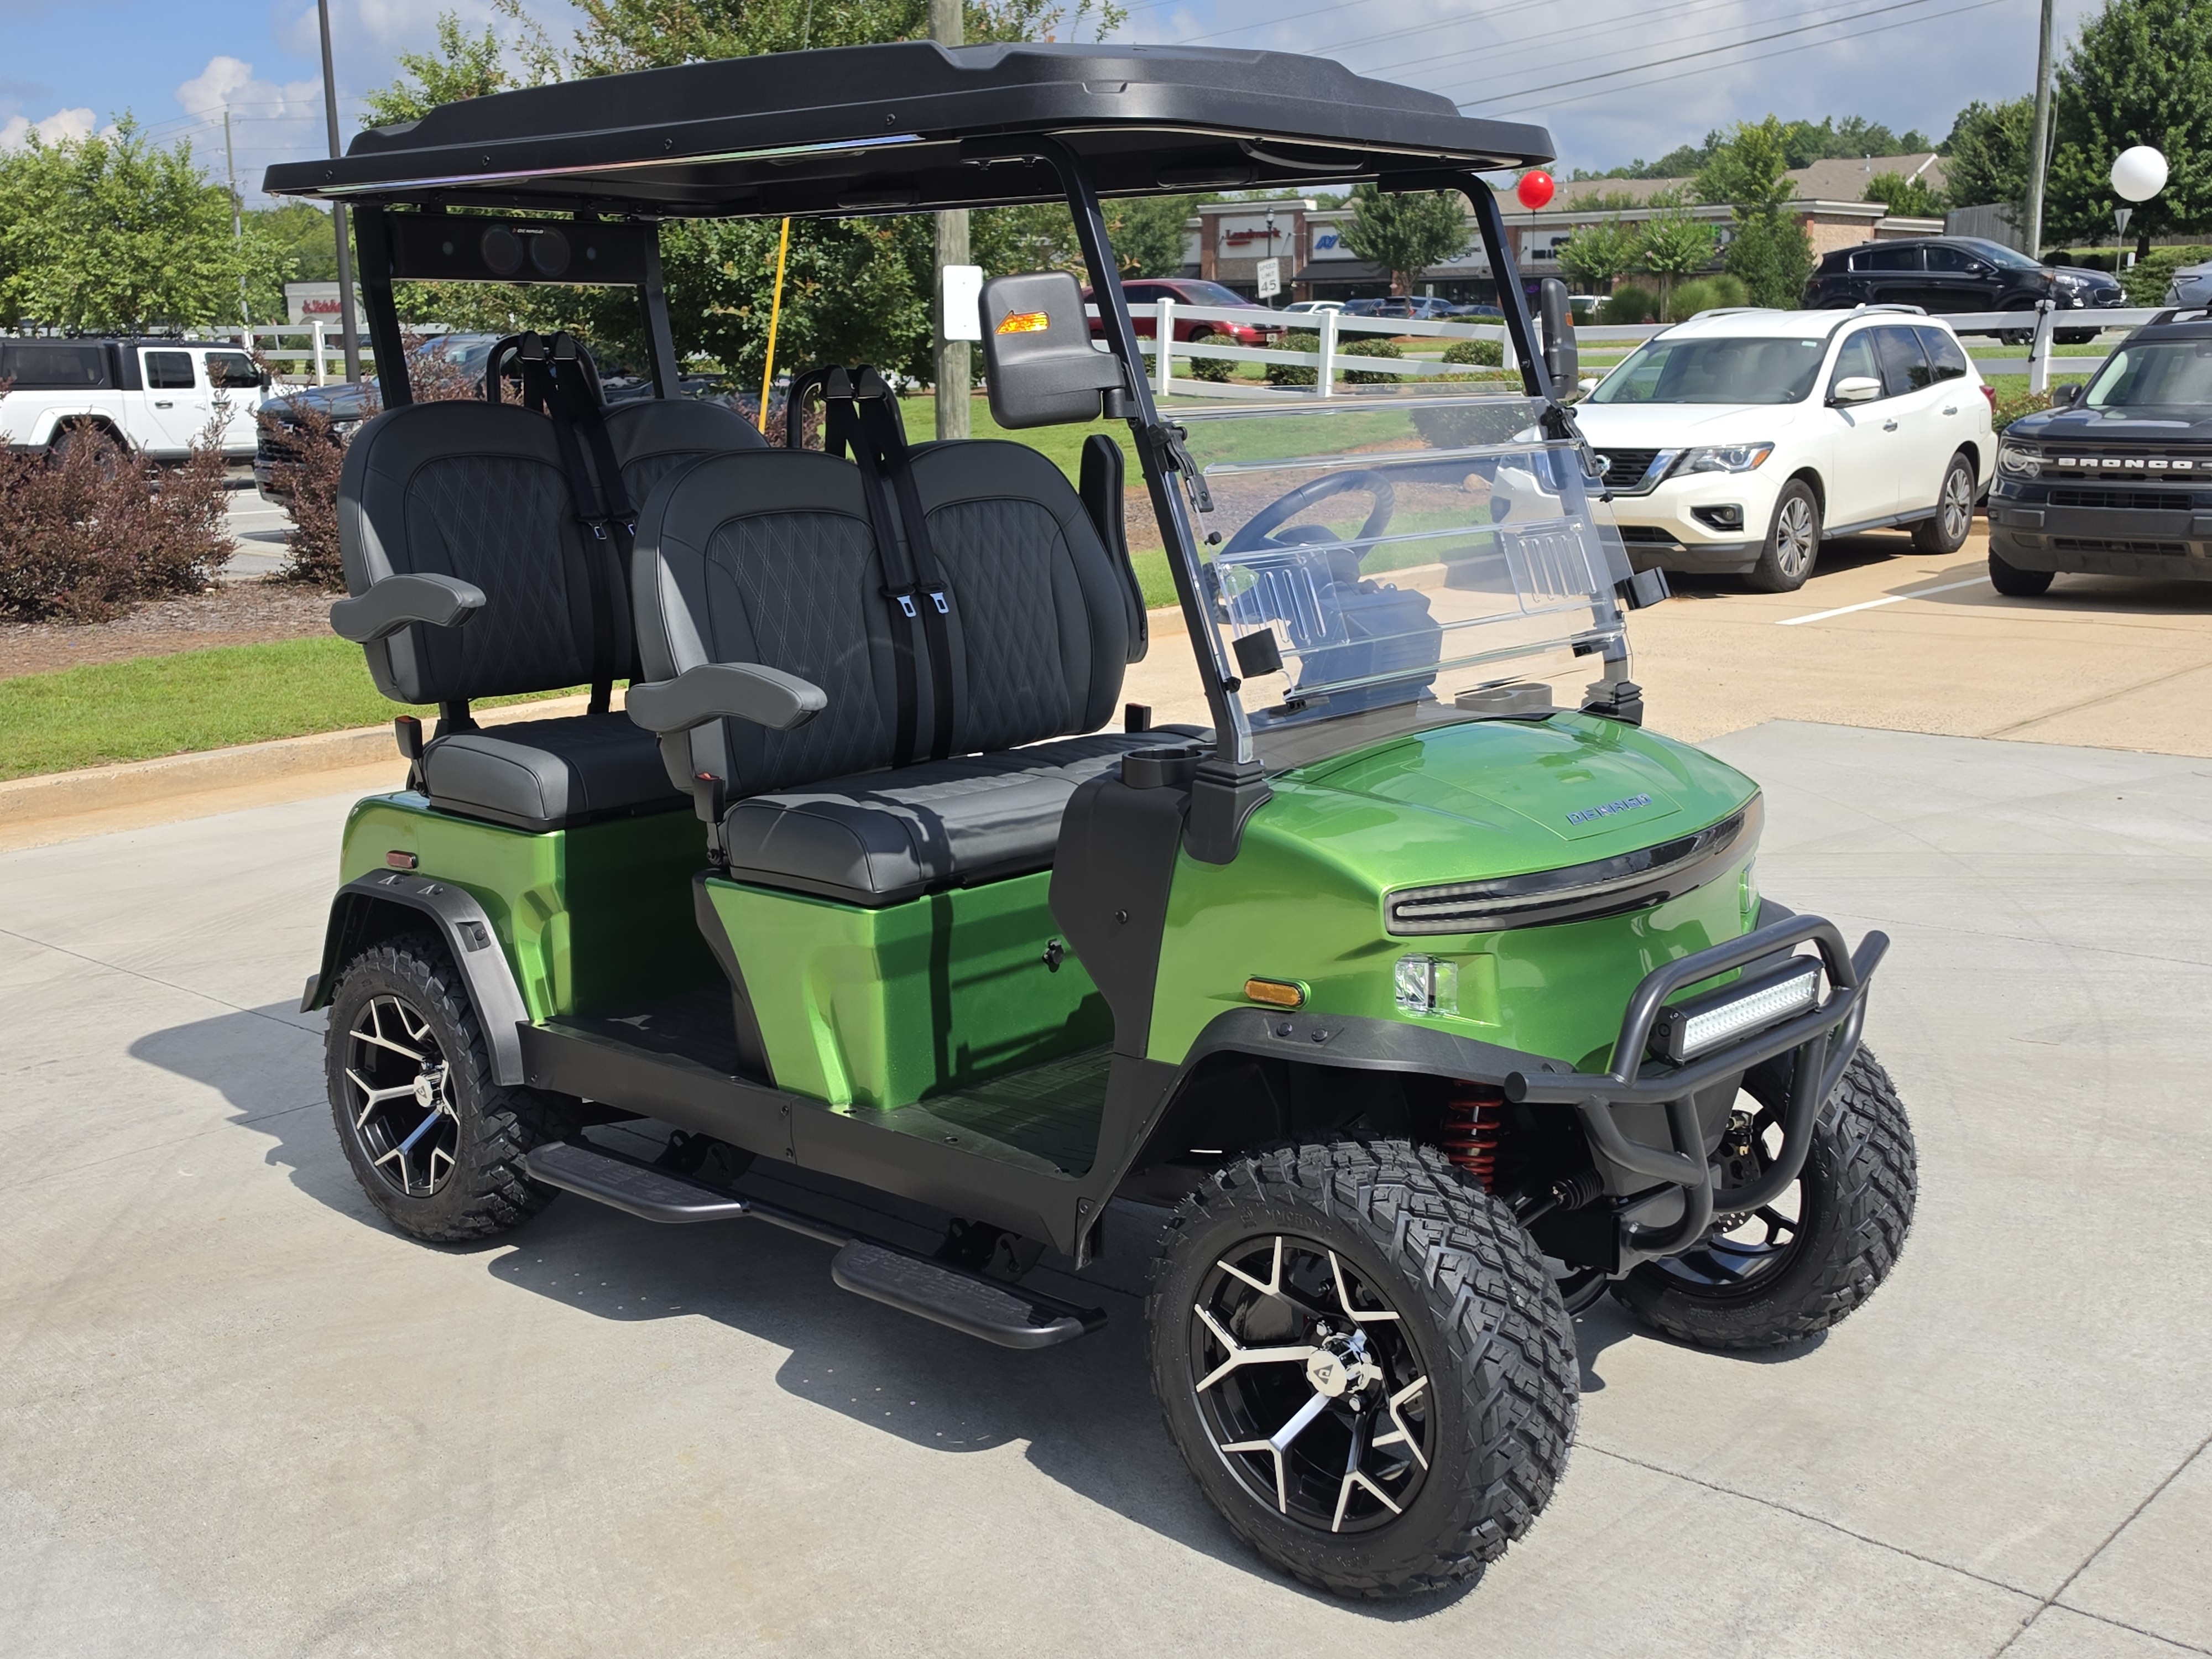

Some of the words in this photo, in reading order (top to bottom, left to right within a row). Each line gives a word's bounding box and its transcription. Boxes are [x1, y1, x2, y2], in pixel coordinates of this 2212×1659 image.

[1259, 262, 1276, 272] SPEED
[1261, 270, 1275, 279] LIMIT
[1260, 279, 1276, 292] 45
[2058, 458, 2193, 469] BRONCO
[1566, 792, 1652, 826] DENAGO
